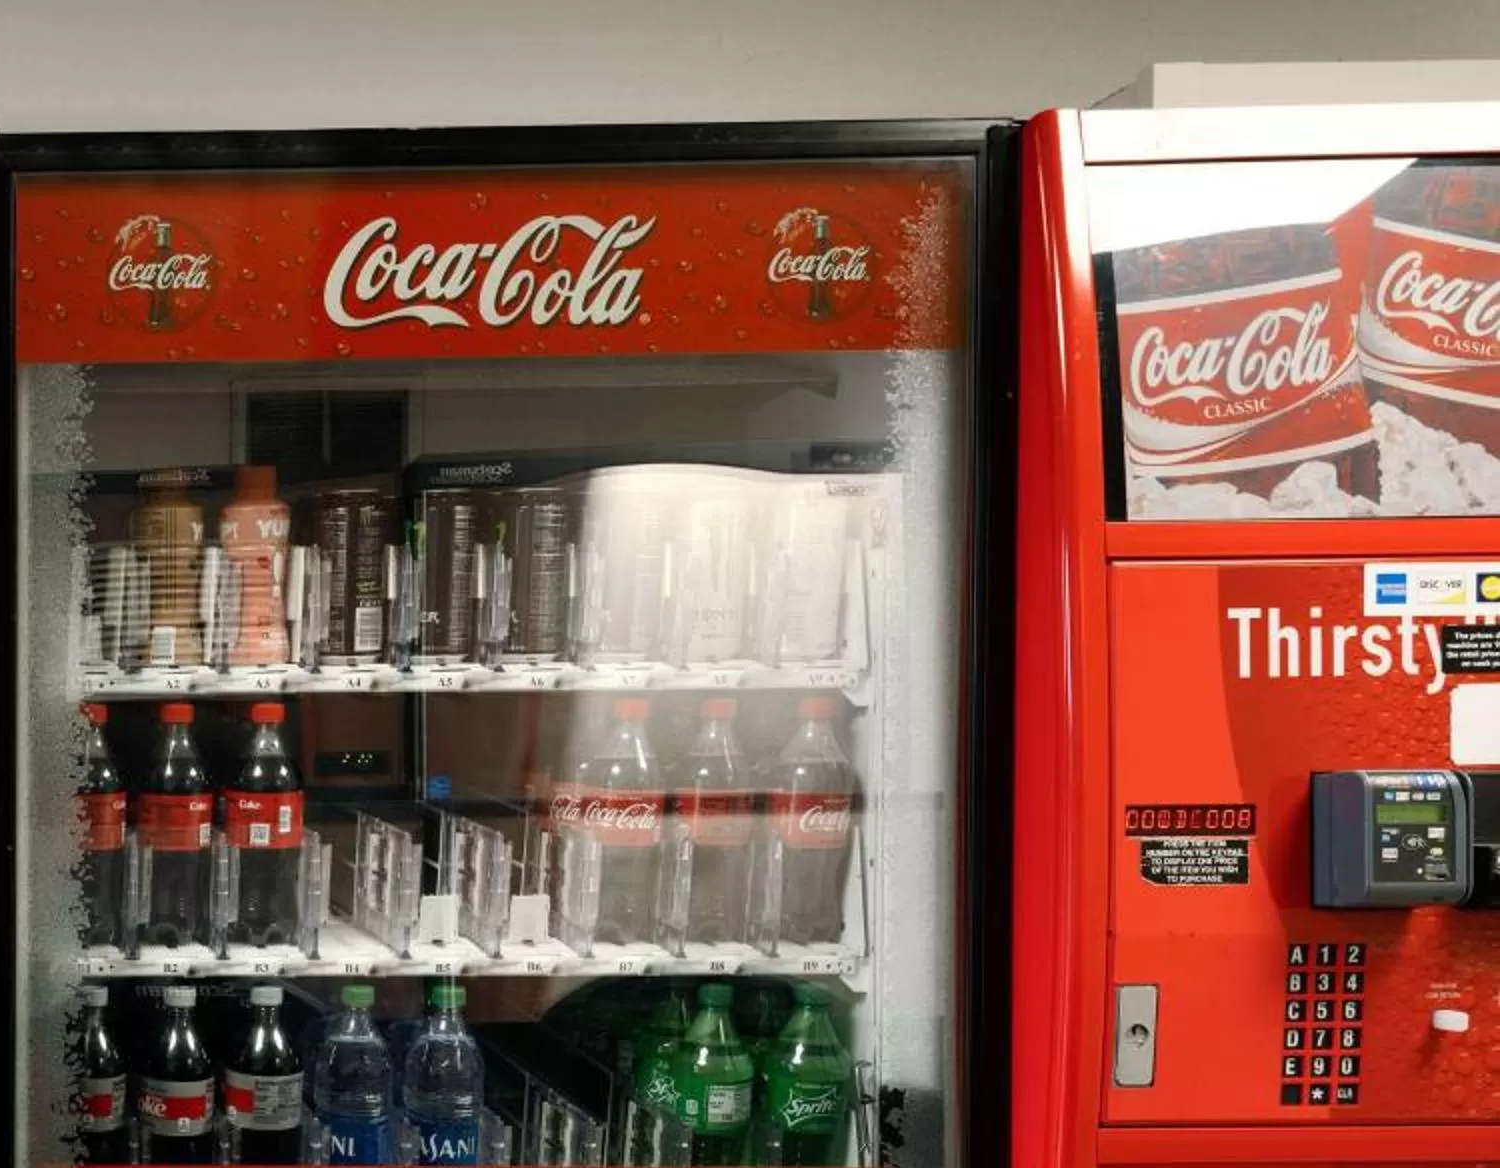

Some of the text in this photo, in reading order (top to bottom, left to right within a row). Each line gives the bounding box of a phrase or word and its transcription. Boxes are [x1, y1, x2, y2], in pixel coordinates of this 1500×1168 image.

[108, 252, 212, 291] Coca-Cola
[323, 214, 656, 329] Coca-Cola
[767, 245, 870, 283] Coca-Cola
[1377, 251, 1500, 338] Coca-C
[1130, 300, 1338, 406] Coca-Cola
[1433, 334, 1497, 357] CLASSIC
[1204, 398, 1270, 420] CLASSIC
[1228, 607, 1446, 695] Thirsty
[584, 801, 660, 830] Coca-Cola
[1291, 946, 1359, 963] A 1 2
[1289, 974, 1357, 991] B 3 4
[1288, 1002, 1355, 1019] C 5 6
[1287, 1030, 1353, 1047] D 7 8
[1286, 1058, 1352, 1074] E 9 0
